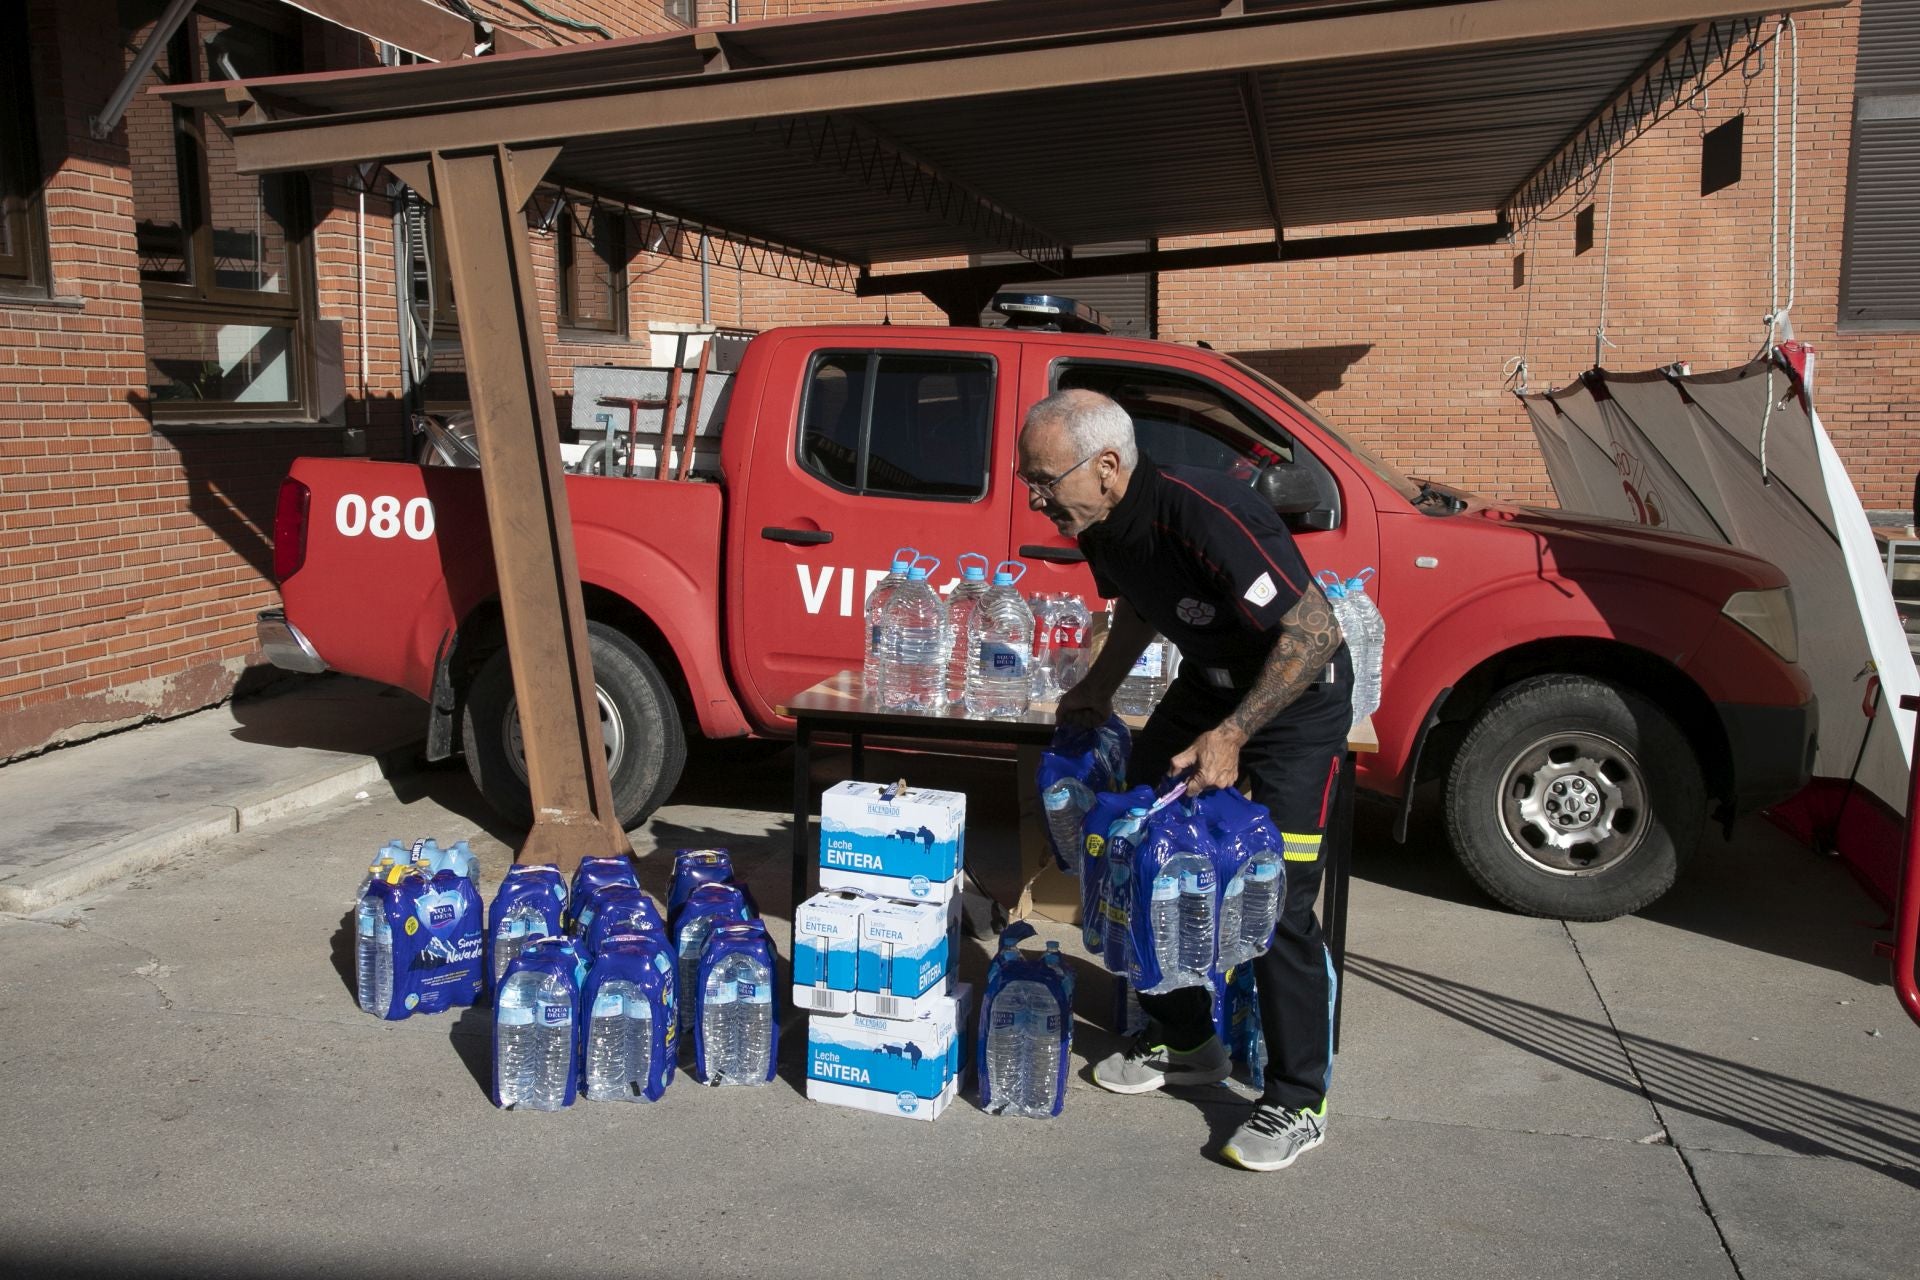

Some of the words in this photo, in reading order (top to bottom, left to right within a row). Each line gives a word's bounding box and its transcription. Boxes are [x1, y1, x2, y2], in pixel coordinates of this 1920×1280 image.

[335, 493, 436, 541] 080
[867, 803, 901, 816] HACENDADO
[827, 838, 853, 849] Leche
[827, 849, 883, 870] ENTERA
[432, 907, 453, 916] AQUA
[433, 912, 453, 921] DEUS
[805, 921, 838, 935] ENTERA
[870, 920, 886, 928] Leche
[870, 927, 903, 940] ENTERA
[457, 937, 482, 950] Sierra
[446, 945, 482, 964] Nevada
[919, 964, 942, 991] ENTERA
[854, 1016, 887, 1030] HACENDADO
[815, 1049, 840, 1063] Leche
[814, 1061, 870, 1084] ENTERA
